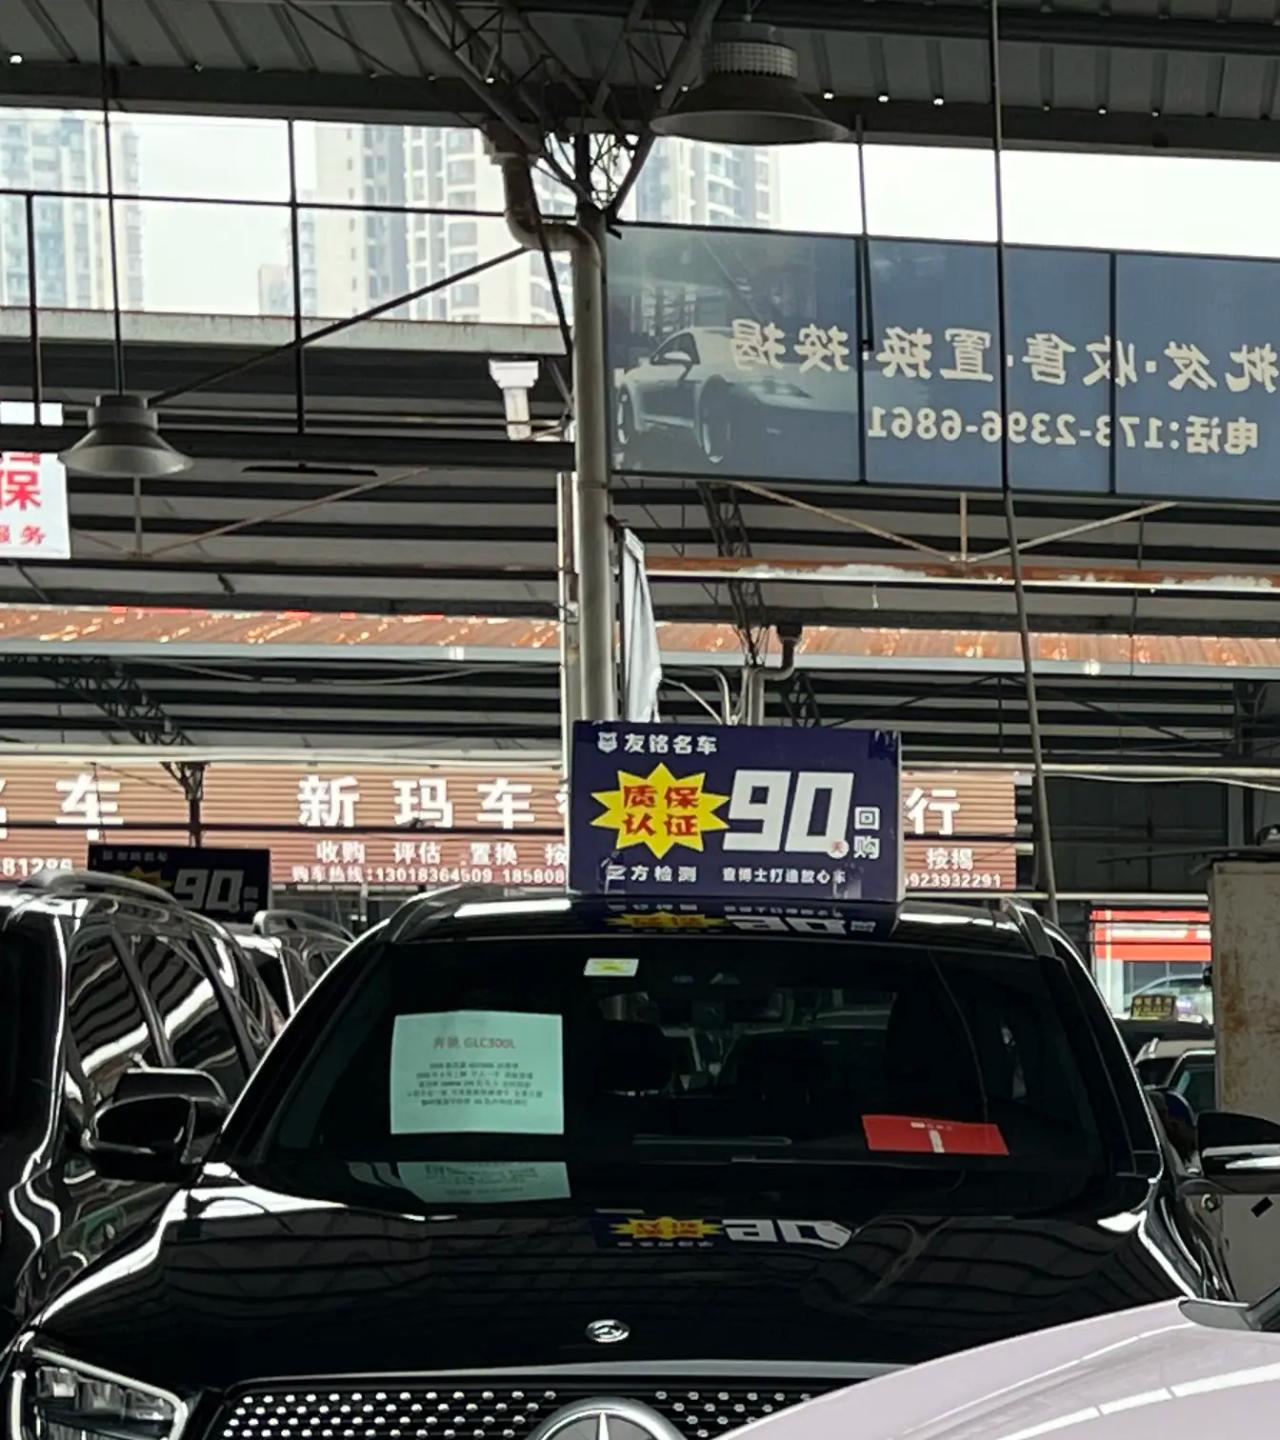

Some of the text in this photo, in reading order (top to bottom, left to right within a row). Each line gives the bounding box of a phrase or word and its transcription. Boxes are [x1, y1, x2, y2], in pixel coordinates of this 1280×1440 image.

[623, 732, 718, 755] 友铭名车
[297, 774, 567, 829] 新玛车
[623, 784, 700, 809] 质保
[722, 769, 855, 853] 90
[905, 787, 961, 835] 行
[622, 813, 700, 837] 认证
[853, 806, 881, 860] 回购
[316, 840, 366, 865] 收购
[393, 842, 441, 865] 评估
[470, 843, 518, 866] 置换
[926, 847, 975, 871] 按揭
